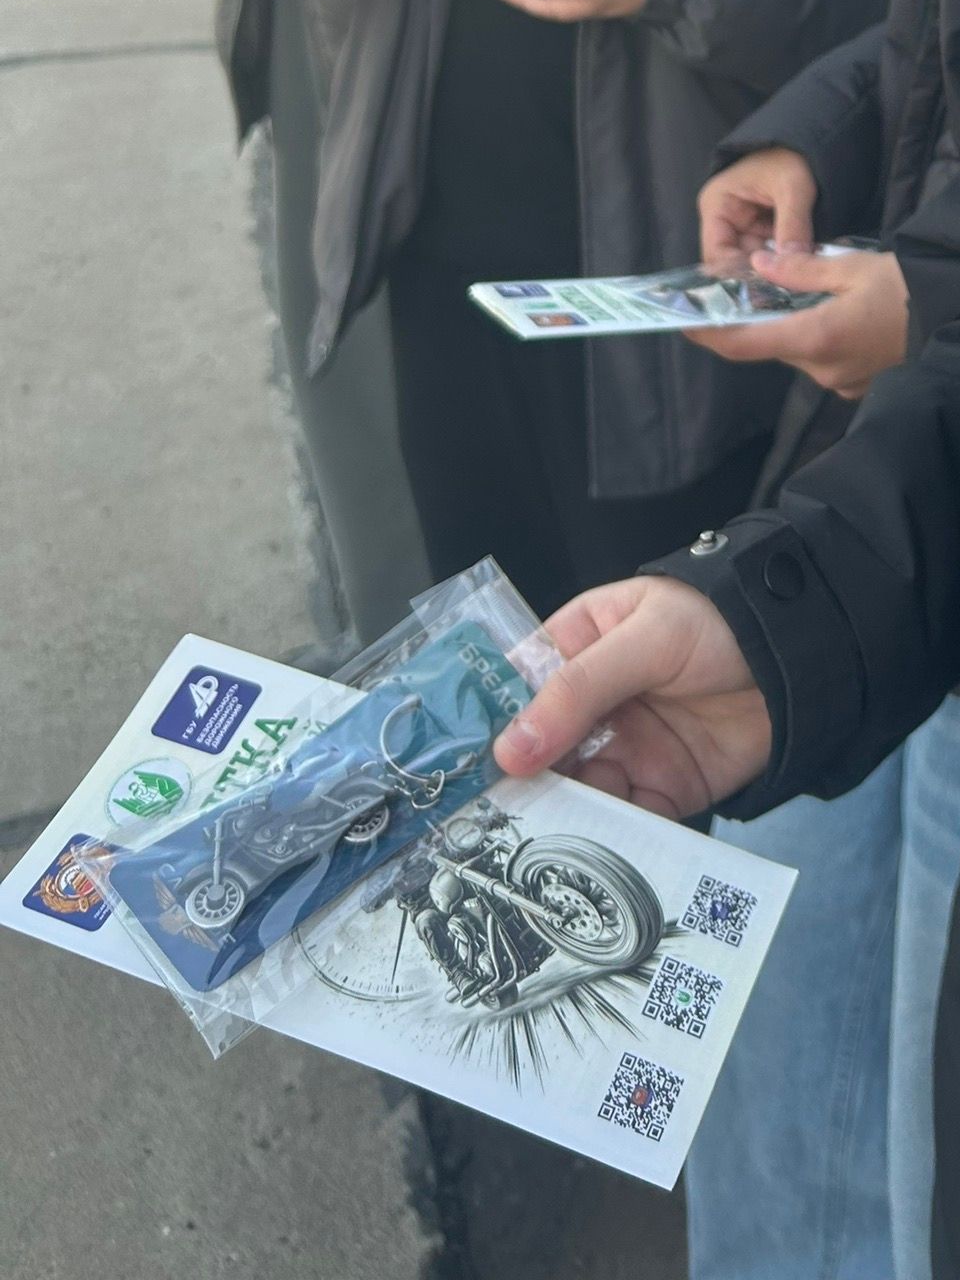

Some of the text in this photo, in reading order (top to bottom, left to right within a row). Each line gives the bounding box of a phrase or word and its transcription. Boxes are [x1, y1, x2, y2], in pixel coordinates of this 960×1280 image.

[459, 642, 525, 716] БРЕЛО
[182, 720, 197, 739] ГБУ
[196, 683, 239, 743] БЕЗОПАСНОСТЬ
[204, 696, 239, 746] ДОРОЖНОГО
